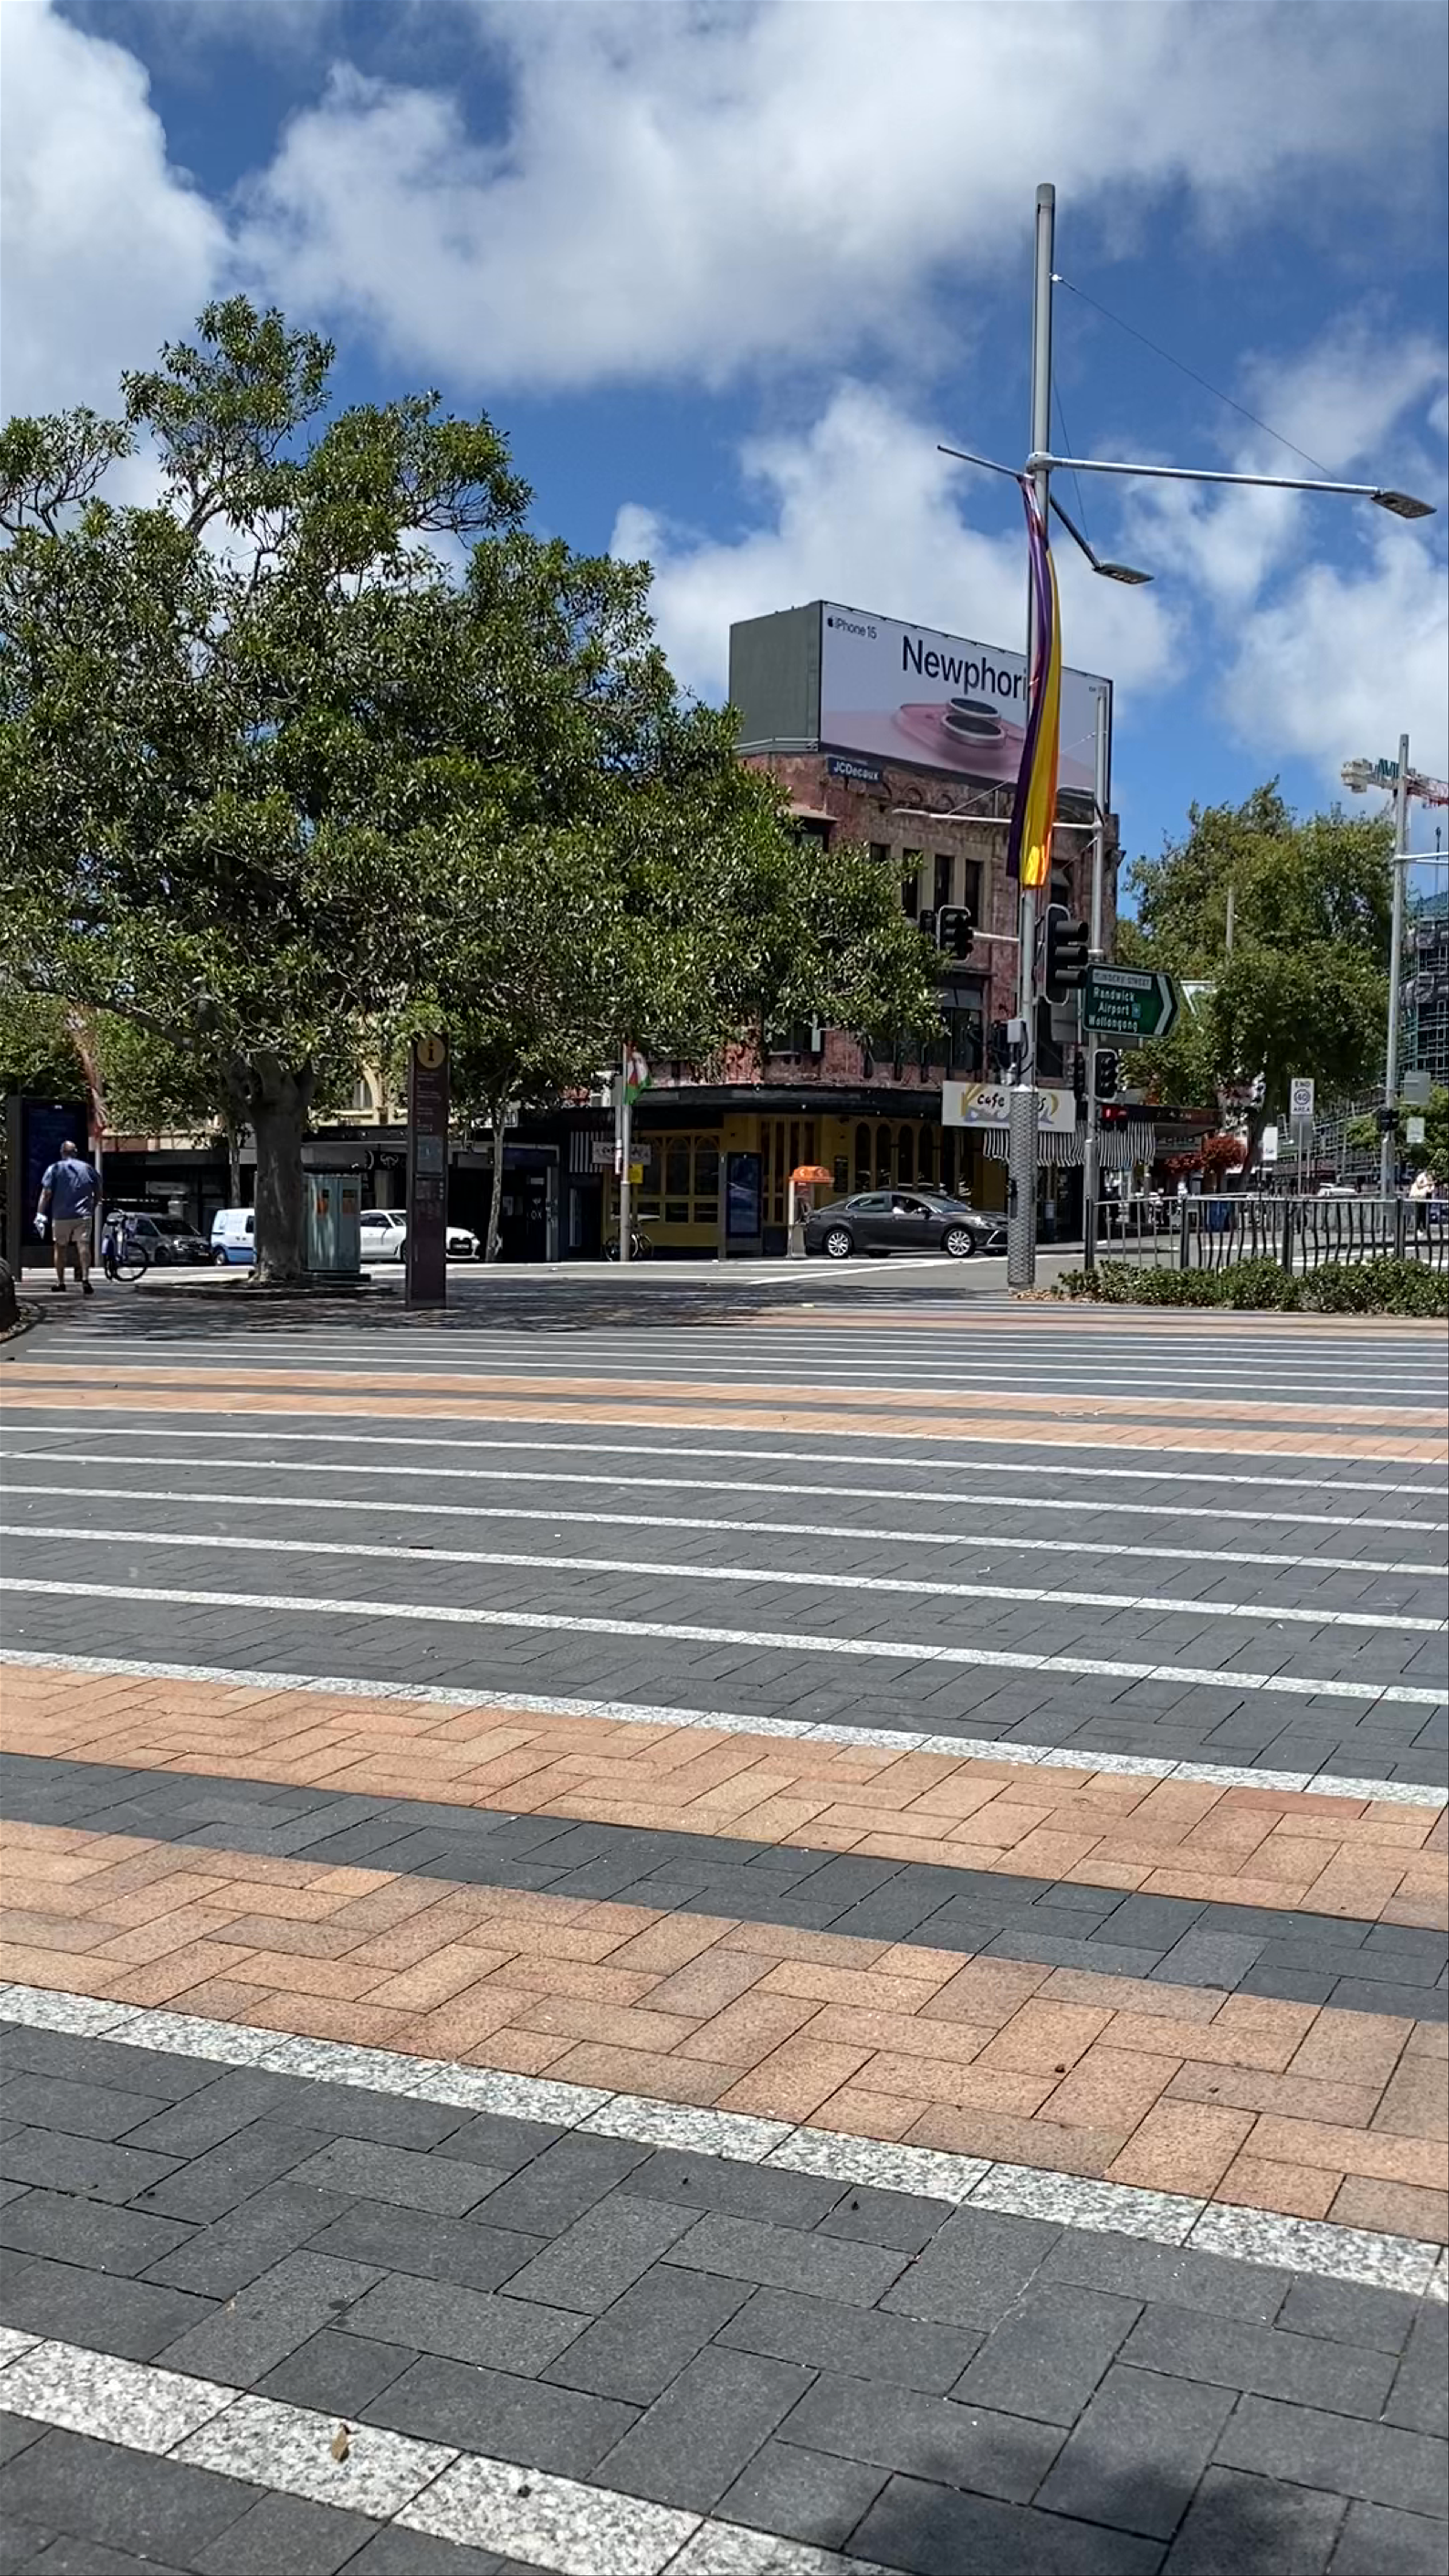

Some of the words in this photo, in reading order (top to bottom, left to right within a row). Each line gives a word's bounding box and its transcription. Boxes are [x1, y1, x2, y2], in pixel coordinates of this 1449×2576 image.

[835, 617, 866, 636] iPhone
[867, 625, 877, 640] 15
[903, 635, 1027, 701] Newphori
[834, 761, 879, 780] JCDecaux
[1093, 986, 1135, 1002] Randwick
[1098, 1001, 1129, 1016] Airport
[1089, 1014, 1138, 1033] Wollongong
